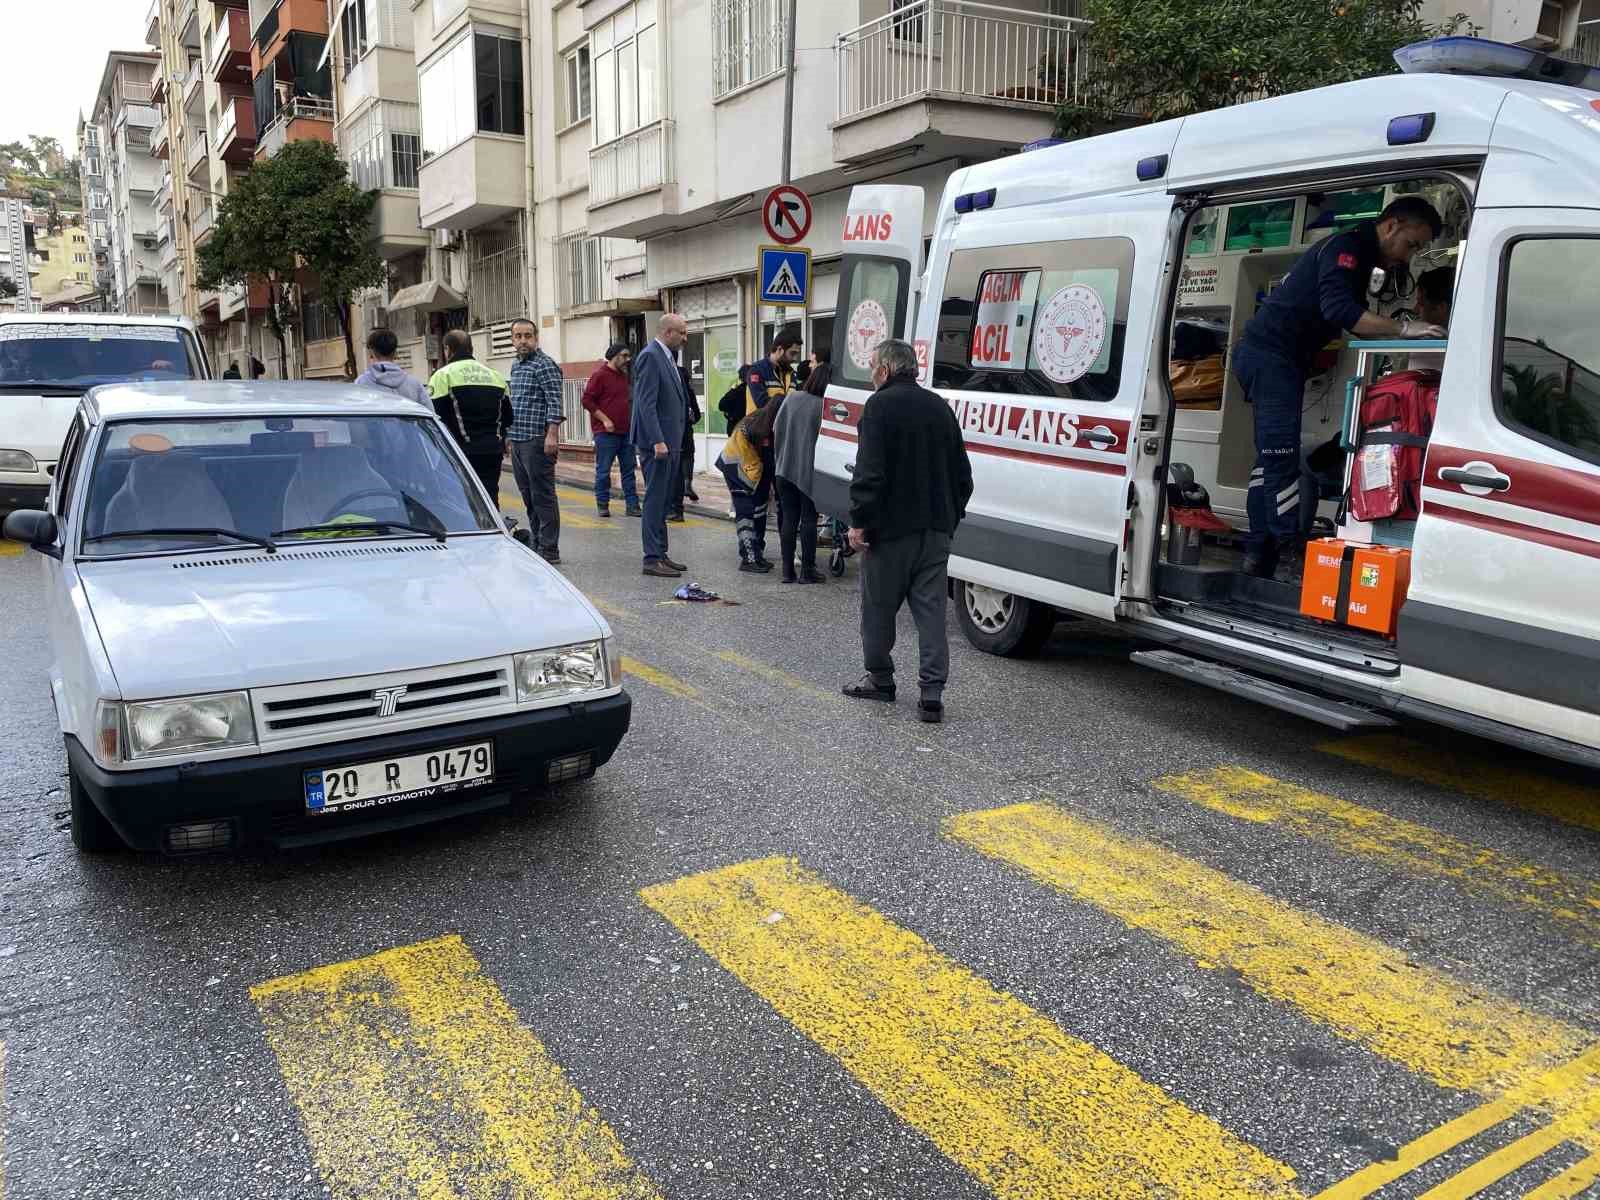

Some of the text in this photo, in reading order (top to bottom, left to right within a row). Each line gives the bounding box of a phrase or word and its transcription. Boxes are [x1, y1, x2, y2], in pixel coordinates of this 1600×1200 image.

[948, 399, 1080, 448] MBULANS
[1321, 595, 1368, 615] Fir Aid
[325, 746, 489, 801] 20 R 0479
[310, 791, 324, 801] TR
[343, 800, 377, 811] ONUR
[377, 788, 436, 805] OTOMOTİV
